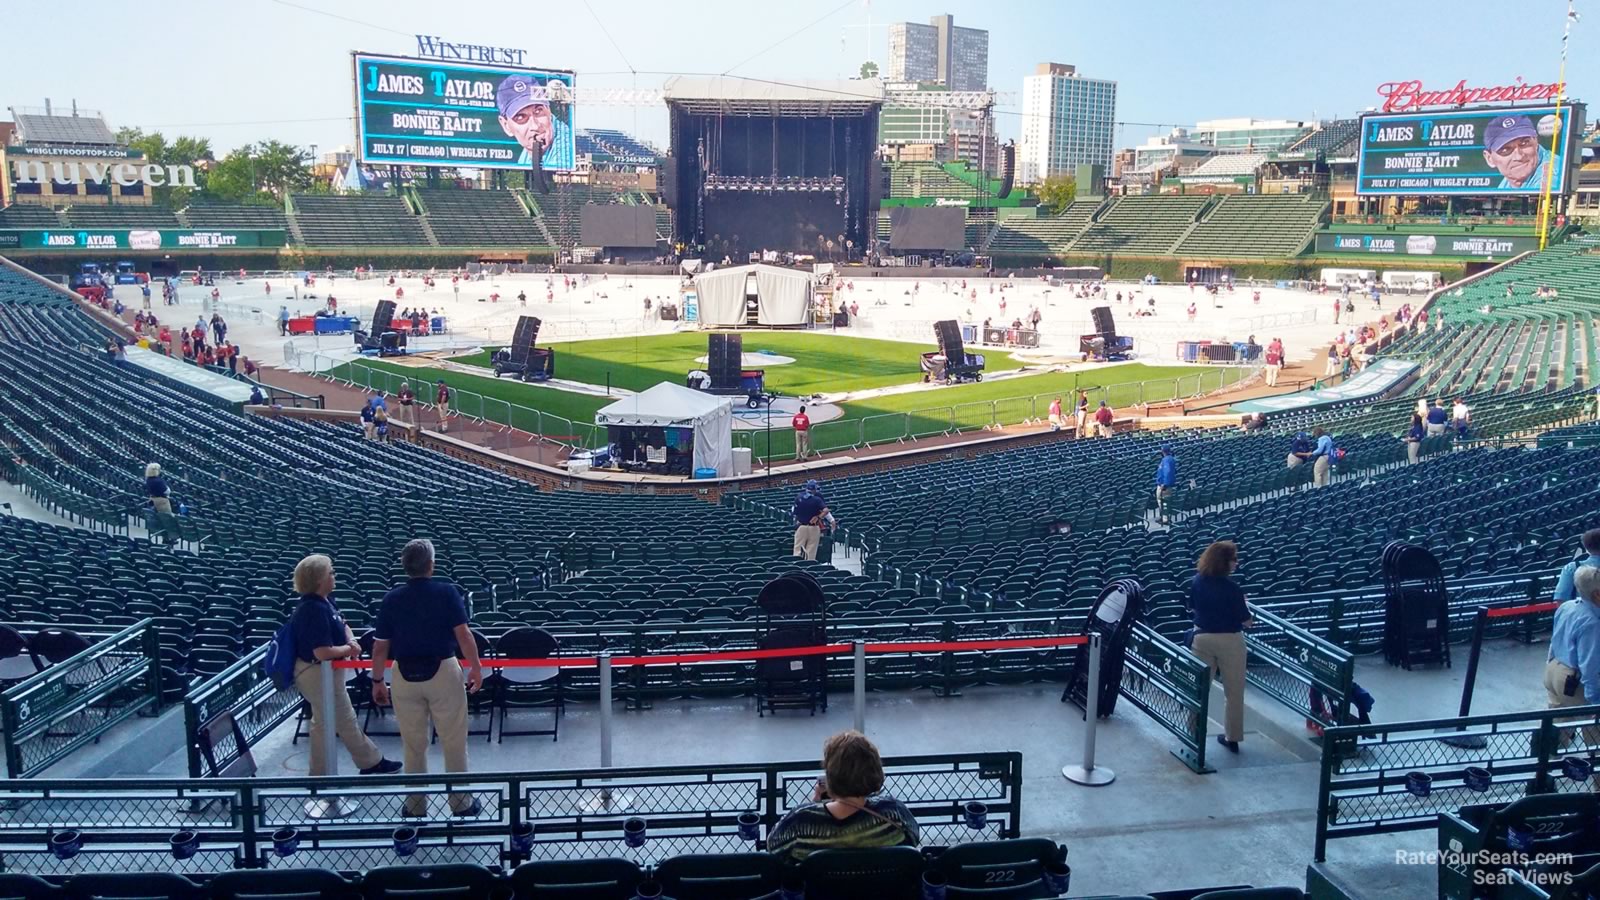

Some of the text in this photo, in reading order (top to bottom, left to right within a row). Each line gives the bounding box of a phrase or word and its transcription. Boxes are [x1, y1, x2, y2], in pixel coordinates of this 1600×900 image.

[415, 34, 527, 65] WINTRUST
[367, 66, 495, 100] JAMES TAYLOR
[1377, 76, 1566, 112] Budweiser
[392, 113, 482, 132] BONNIE RAITT
[1369, 120, 1474, 143] JAMES TAYLOR
[25, 147, 127, 157] WRIGLEYROOFTOPS.COM
[372, 143, 513, 159] JULY 17 CHICAGO WRIGLEY FIELD
[1384, 155, 1460, 169] BONNIE RAITT
[16, 159, 197, 187] nuveen
[1371, 177, 1491, 187] JULY 17 CHICAGO WRIGLEY FIELD
[42, 231, 76, 245] JAMES
[78, 232, 117, 245] TAYLOR
[178, 235, 237, 245] BONNIE RAITT
[1335, 235, 1361, 248] JAMES
[1363, 235, 1395, 249] TAYLOR
[1453, 241, 1513, 252] BONNIE RAITT
[1535, 821, 1565, 834] 222
[984, 870, 1016, 883] 222
